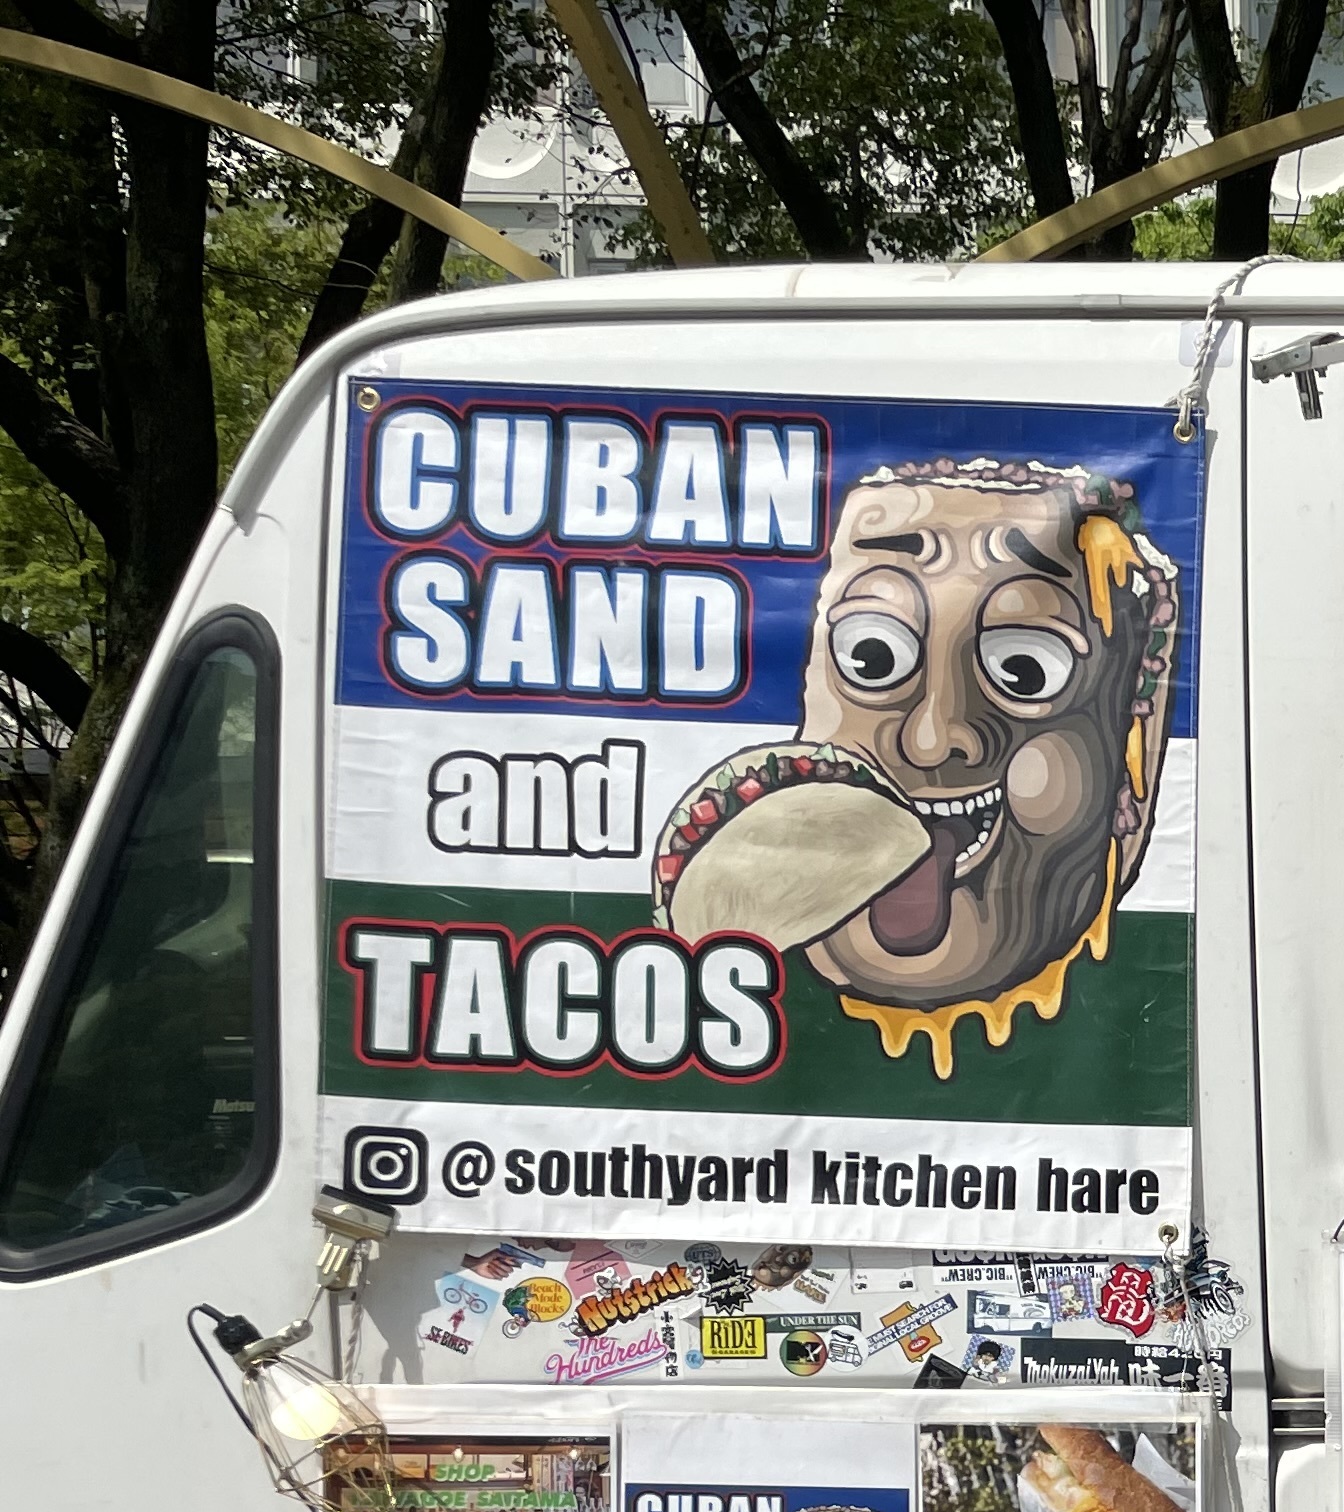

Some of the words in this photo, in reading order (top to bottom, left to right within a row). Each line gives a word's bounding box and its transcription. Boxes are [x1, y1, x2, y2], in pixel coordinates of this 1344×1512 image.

[370, 403, 822, 555] CUBAN
[390, 556, 745, 697] SAND
[428, 739, 645, 858] and
[347, 926, 782, 1075] TACOS
[811, 1148, 1015, 1211] kitchen
[1036, 1157, 1160, 1216] hare
[780, 1316, 814, 1327] UNDER
[816, 1316, 839, 1326] THE
[839, 1315, 859, 1326] SUN
[873, 1326, 896, 1343] MUST
[896, 1307, 929, 1329] SEARCH
[927, 1298, 947, 1314] FOR
[896, 1322, 920, 1340] LOCAL
[919, 1304, 954, 1326] GROOVE
[544, 1328, 667, 1384] Hundreds
[434, 1463, 495, 1482] SHOP
[476, 1490, 579, 1510] SAITAMA
